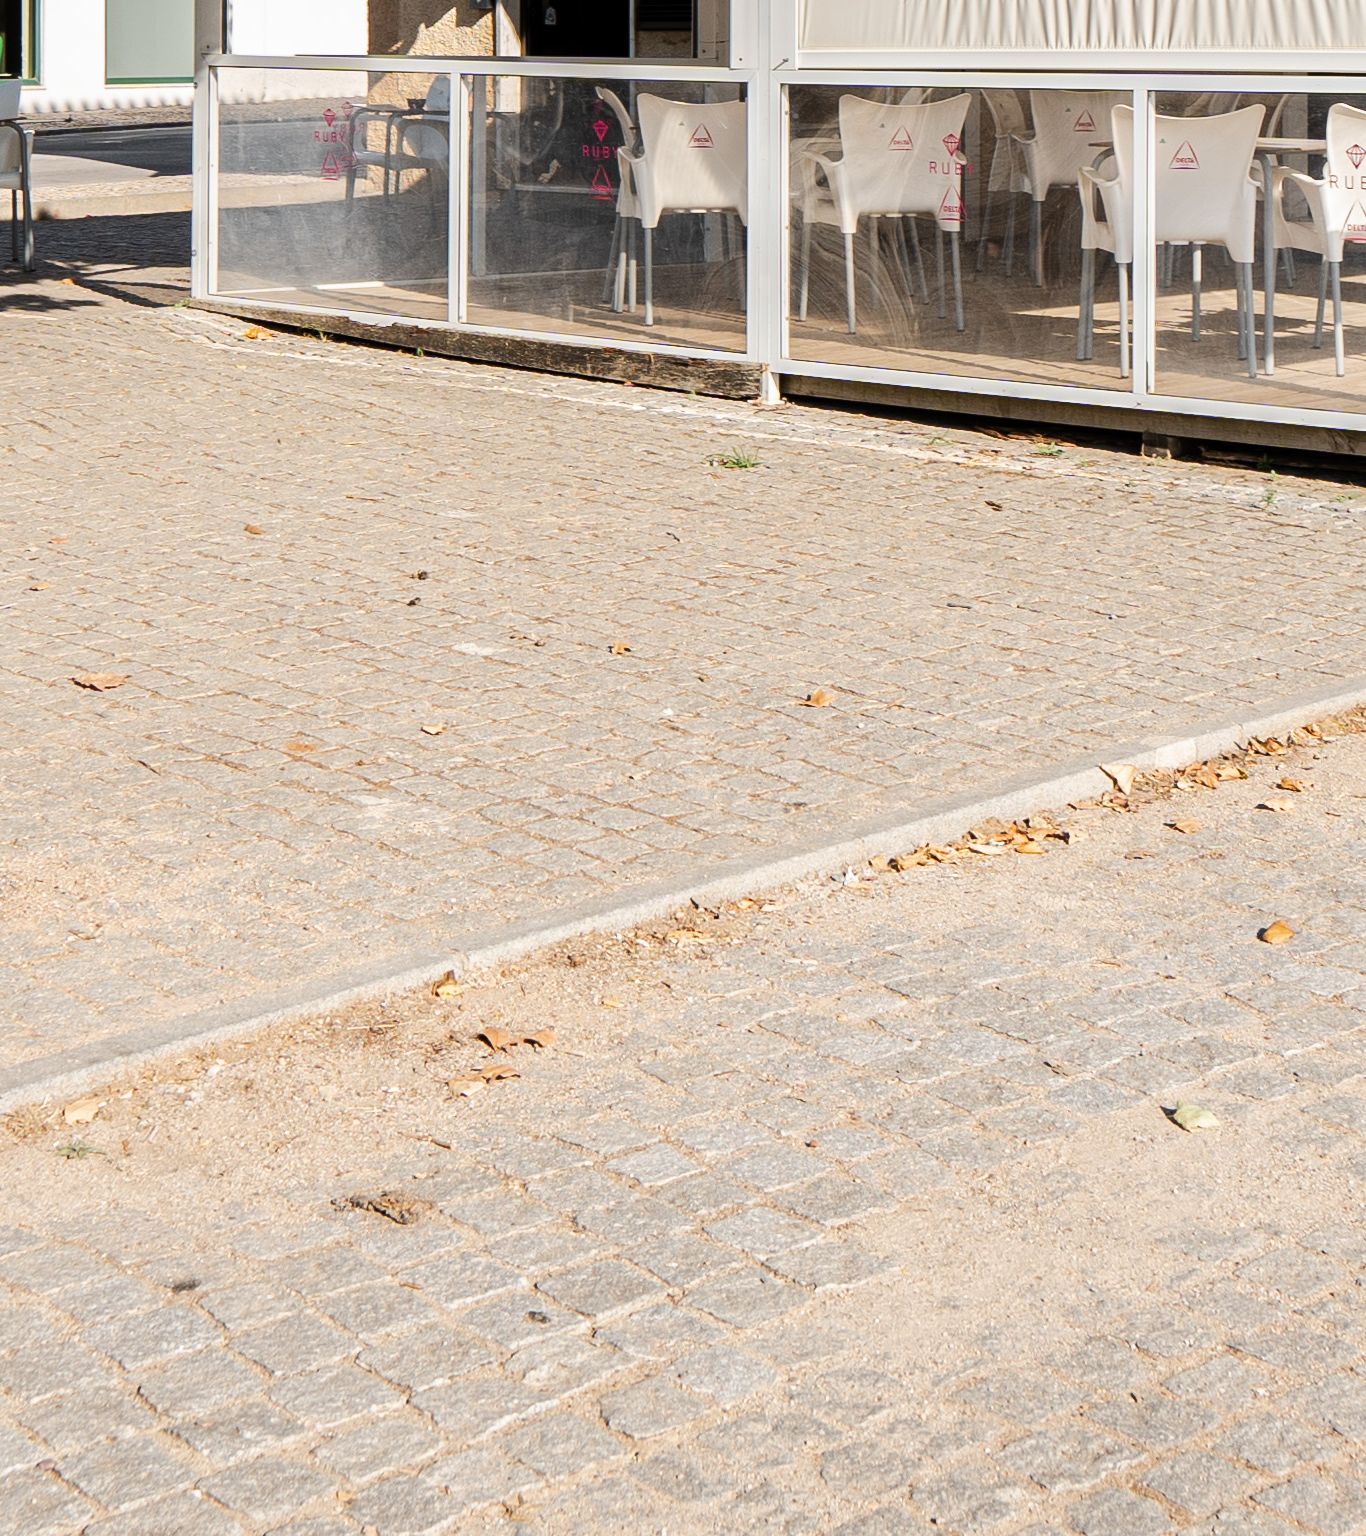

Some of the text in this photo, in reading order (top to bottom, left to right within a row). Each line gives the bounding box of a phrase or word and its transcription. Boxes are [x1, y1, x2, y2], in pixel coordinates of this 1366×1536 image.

[313, 130, 347, 144] RUBY
[581, 143, 620, 160] RUBY
[928, 160, 975, 176] RUBY
